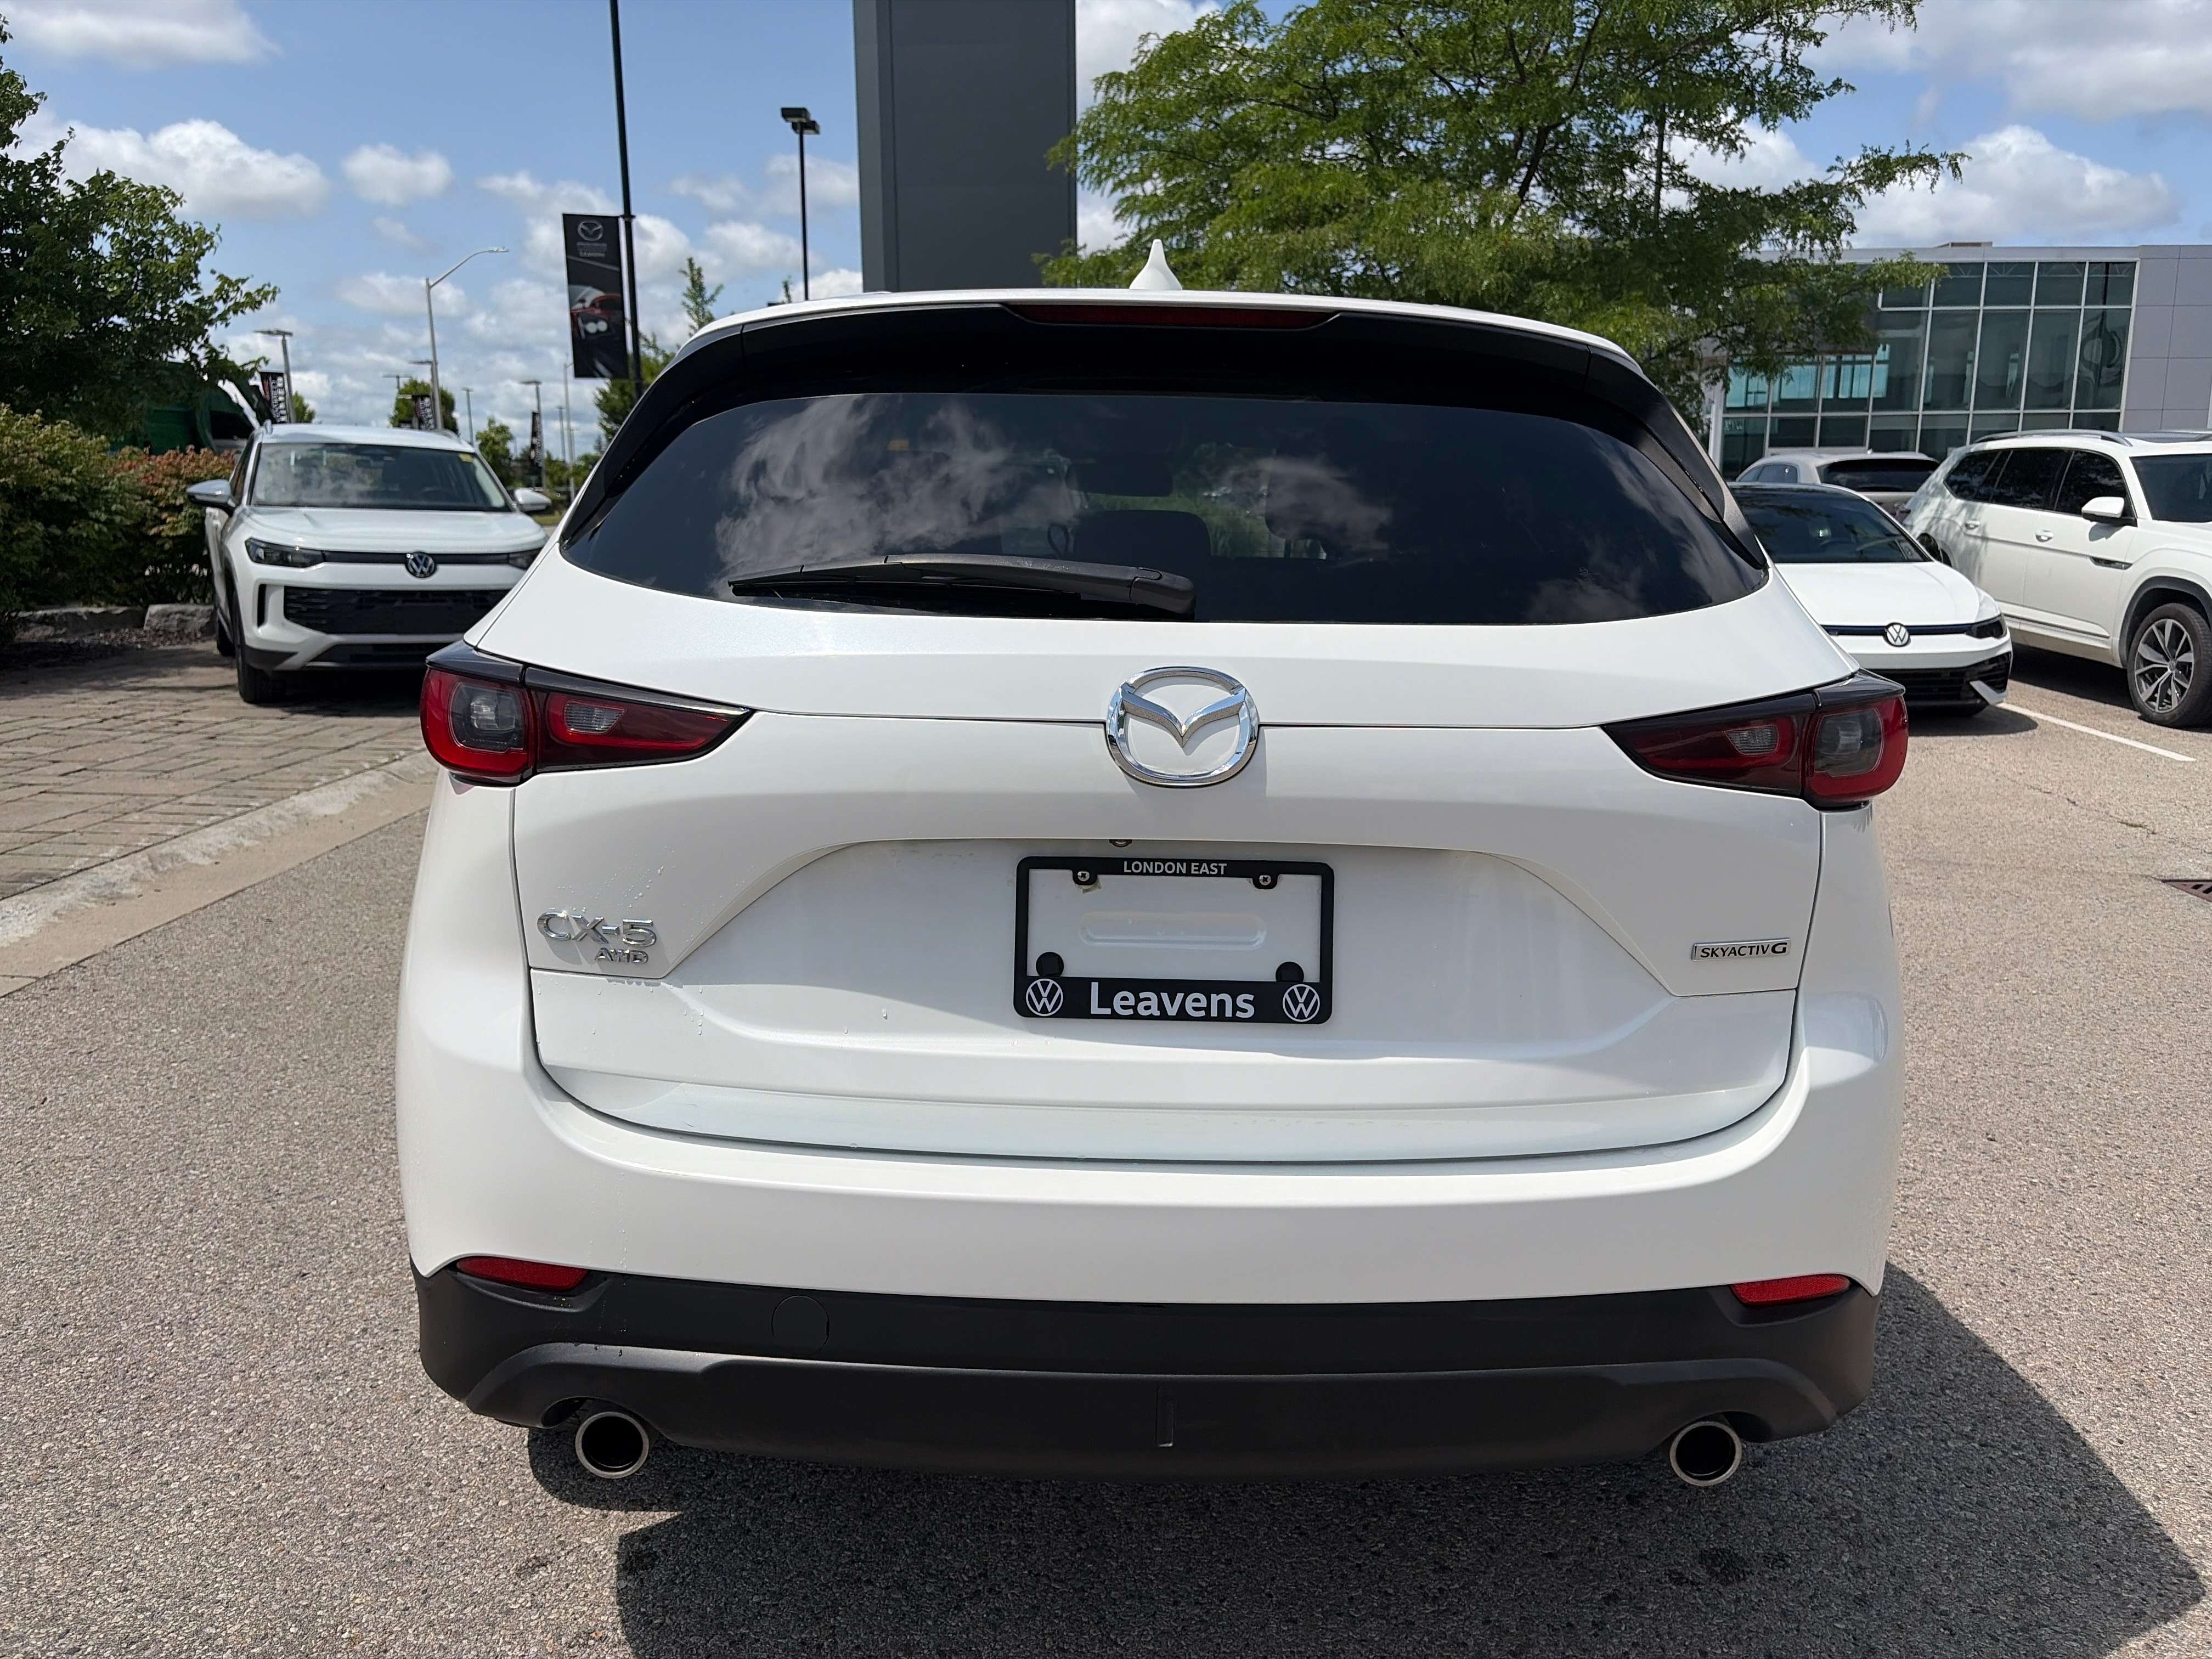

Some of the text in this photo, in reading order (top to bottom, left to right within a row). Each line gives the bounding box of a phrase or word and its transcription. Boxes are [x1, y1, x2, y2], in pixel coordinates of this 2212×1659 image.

[1123, 860, 1227, 876] LONDON EAST
[537, 909, 657, 948] CX-5
[594, 947, 649, 965] AWD
[1090, 981, 1255, 1019] Leavens
